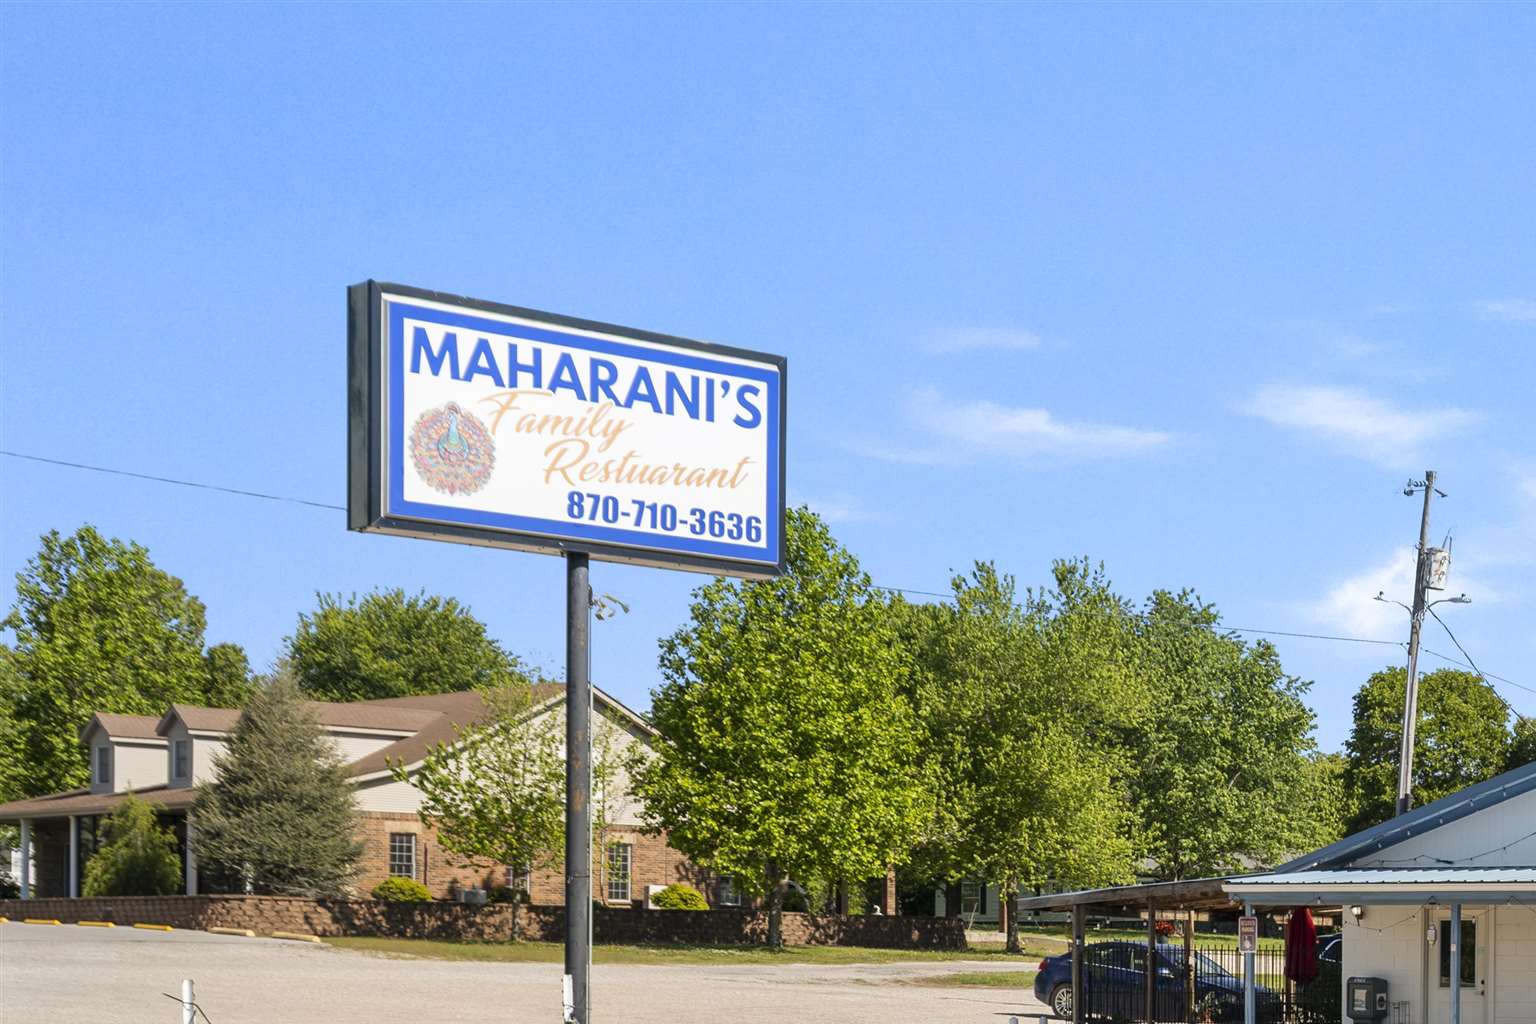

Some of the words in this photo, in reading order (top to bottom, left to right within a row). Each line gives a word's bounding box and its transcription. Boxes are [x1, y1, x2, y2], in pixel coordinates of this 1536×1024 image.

[410, 326, 763, 429] MAHARANI'S
[477, 390, 637, 453] Family
[534, 438, 758, 490] Restuarant
[566, 490, 762, 542] 870-710-3636
